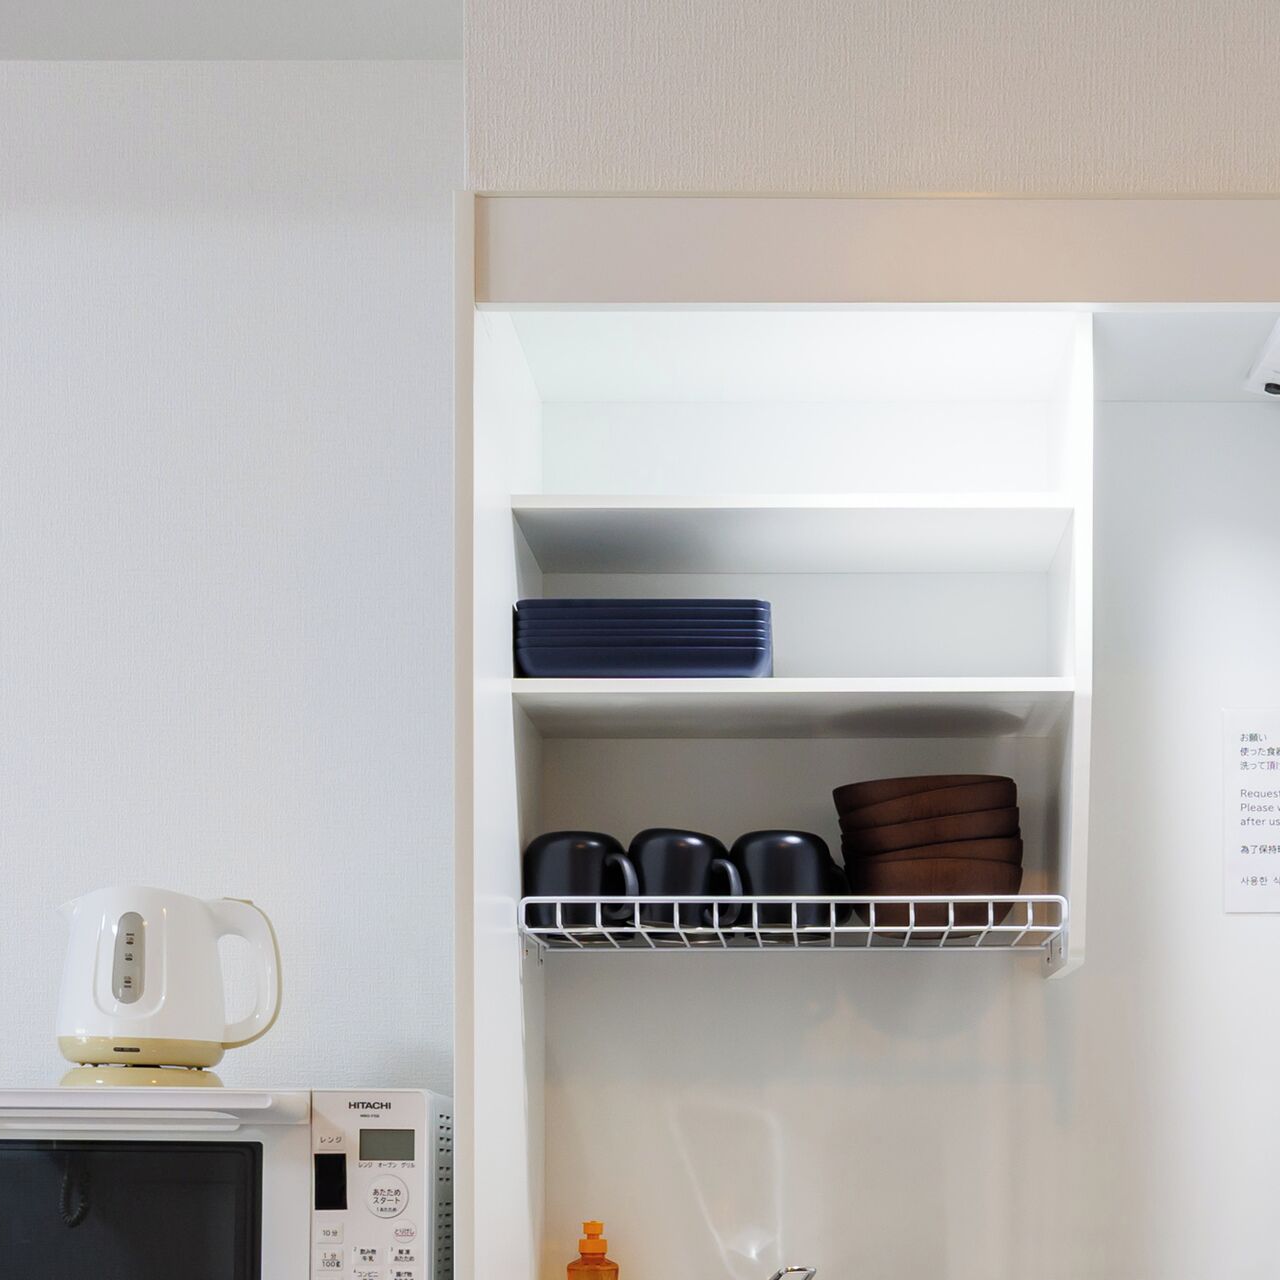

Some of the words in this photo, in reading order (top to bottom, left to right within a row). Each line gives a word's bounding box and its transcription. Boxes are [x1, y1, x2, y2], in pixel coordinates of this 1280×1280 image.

[1239, 733, 1268, 743] お願い
[1240, 803, 1274, 813] Please
[1240, 817, 1266, 827] after
[1240, 875, 1268, 886] 사용한
[348, 1101, 392, 1110] HITACHI
[372, 1188, 402, 1197] あたため
[372, 1196, 402, 1205] スタート
